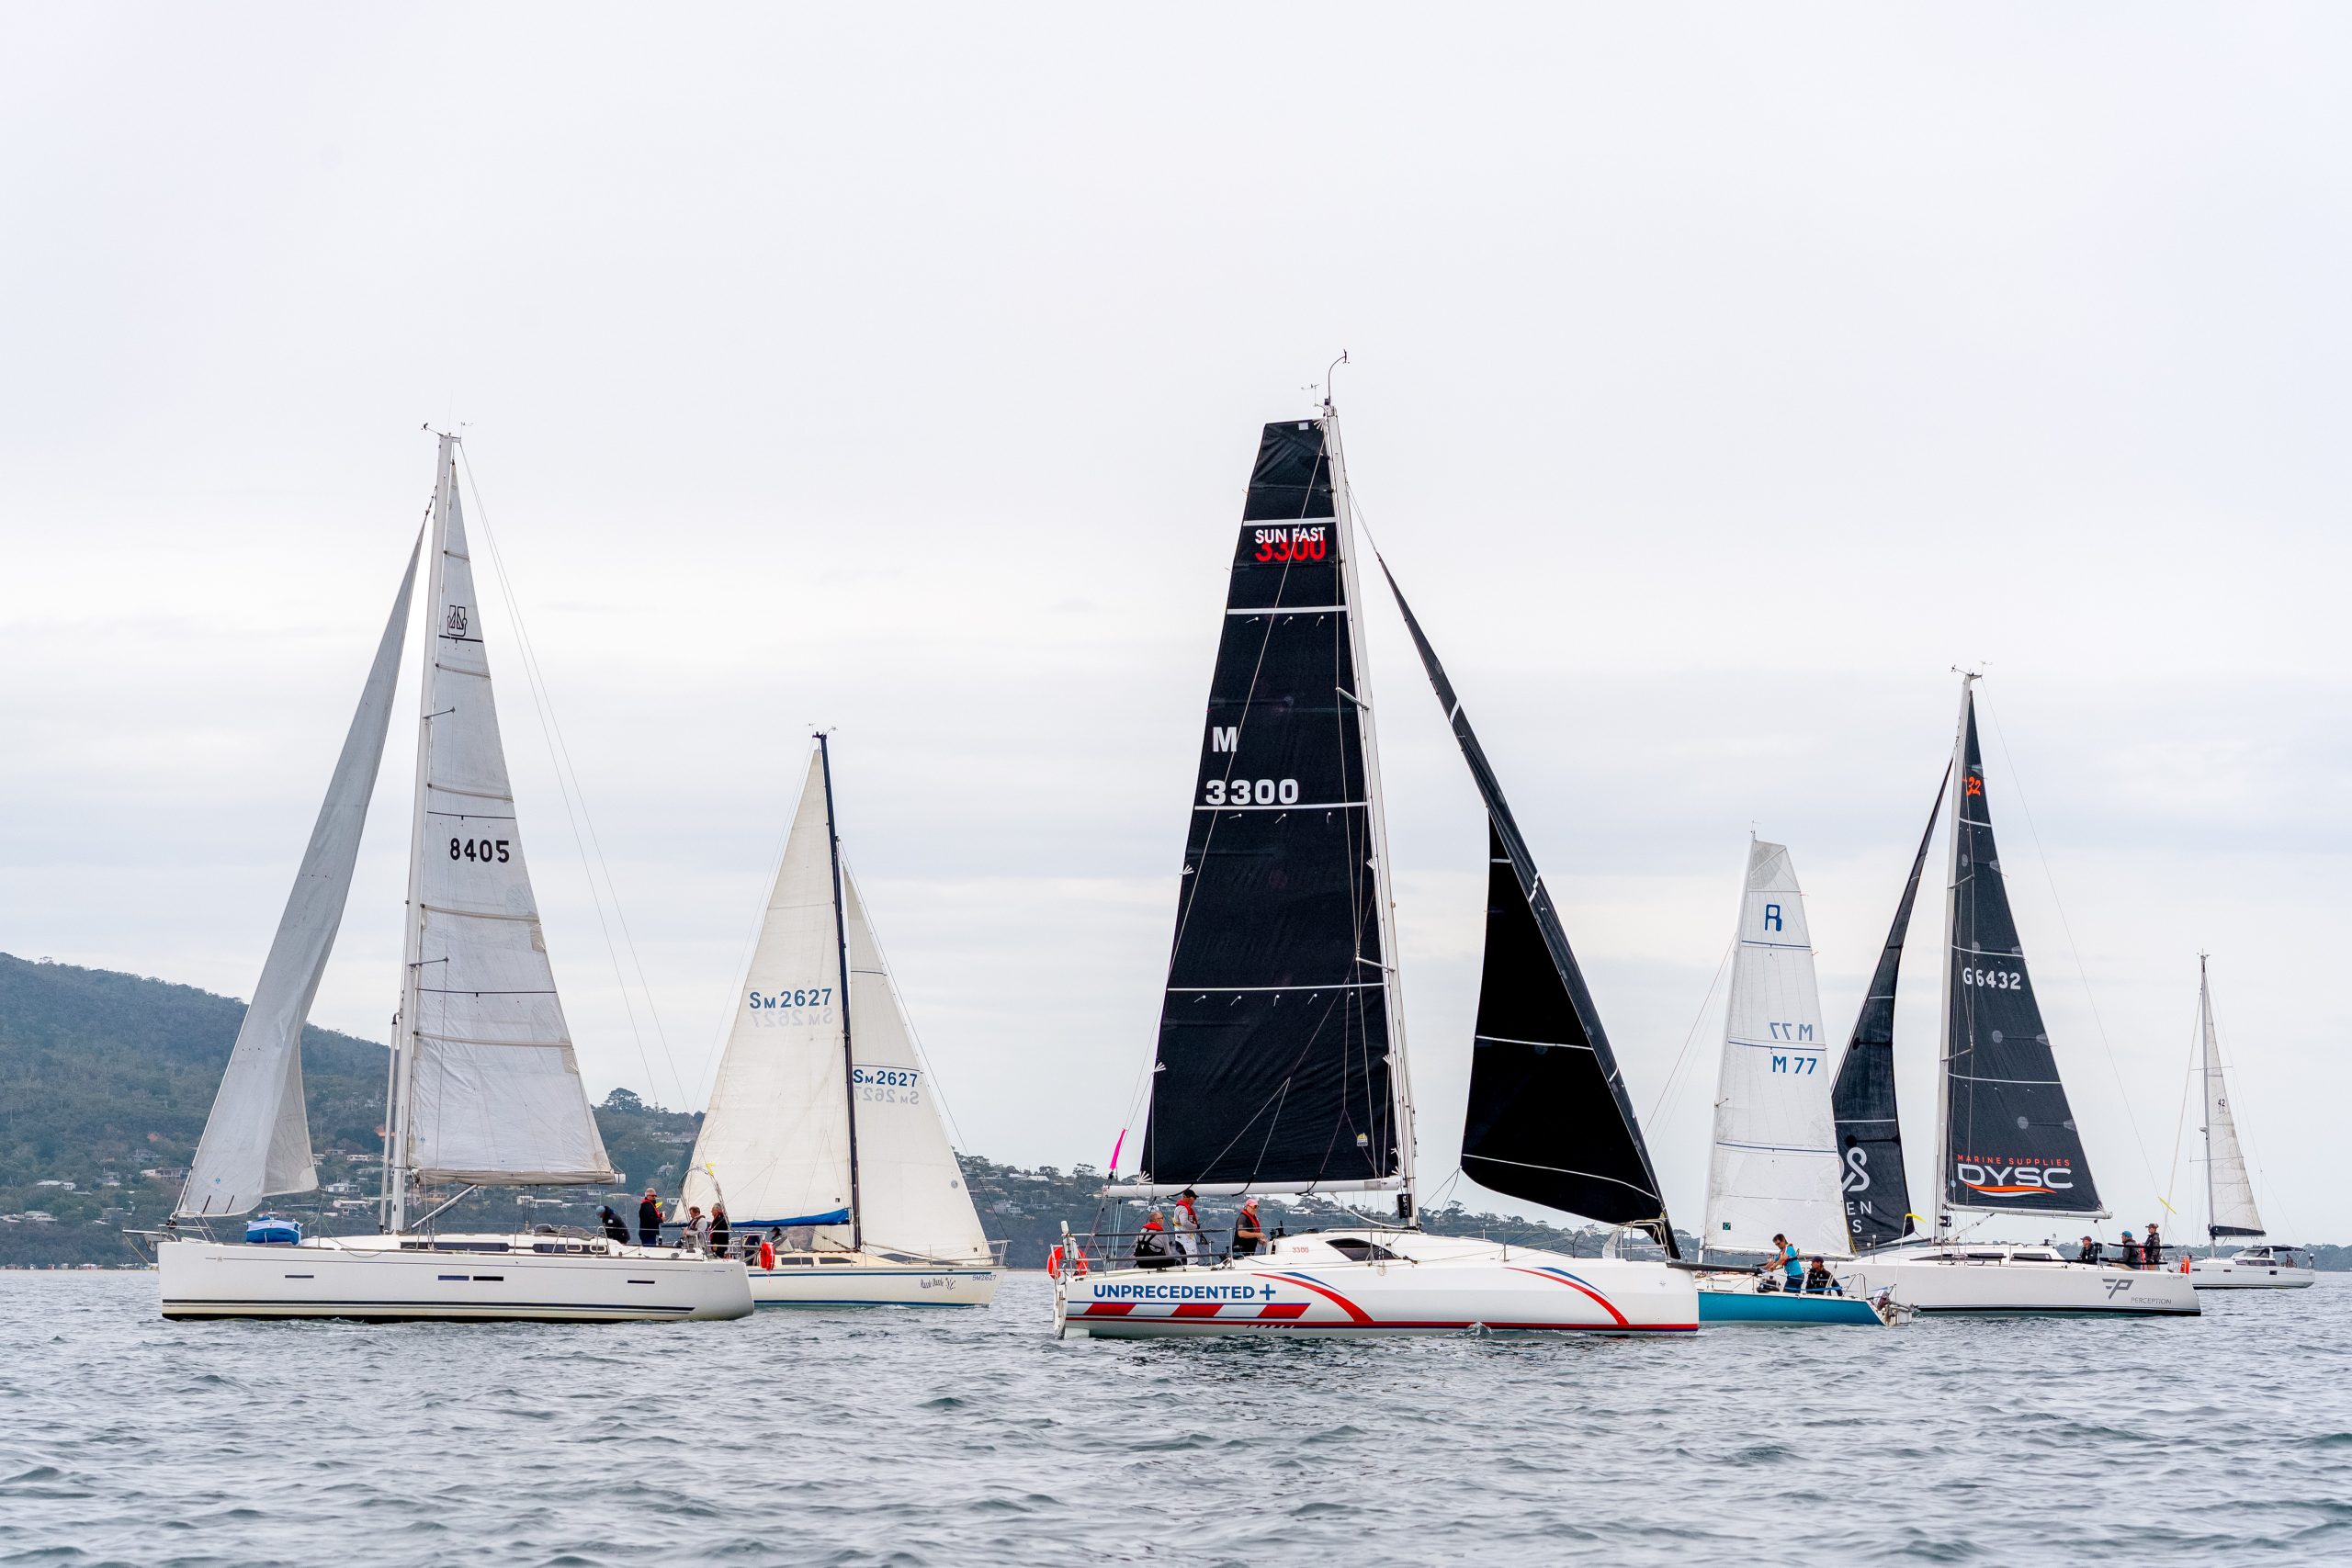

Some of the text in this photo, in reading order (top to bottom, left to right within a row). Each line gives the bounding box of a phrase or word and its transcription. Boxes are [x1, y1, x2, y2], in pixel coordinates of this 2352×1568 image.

[1255, 526, 1326, 544] SUN FAST
[1213, 726, 1238, 752] M
[1205, 778, 1299, 805] 3300
[449, 837, 510, 863] 8405
[2217, 1098, 2226, 1107] 42
[1957, 1154, 2071, 1167] MARINE SUPPLIES
[1957, 1163, 2074, 1190] DYSC
[1093, 1284, 1255, 1299] UNPRECEDENTED
[2131, 1296, 2172, 1304] PERCEPTION
